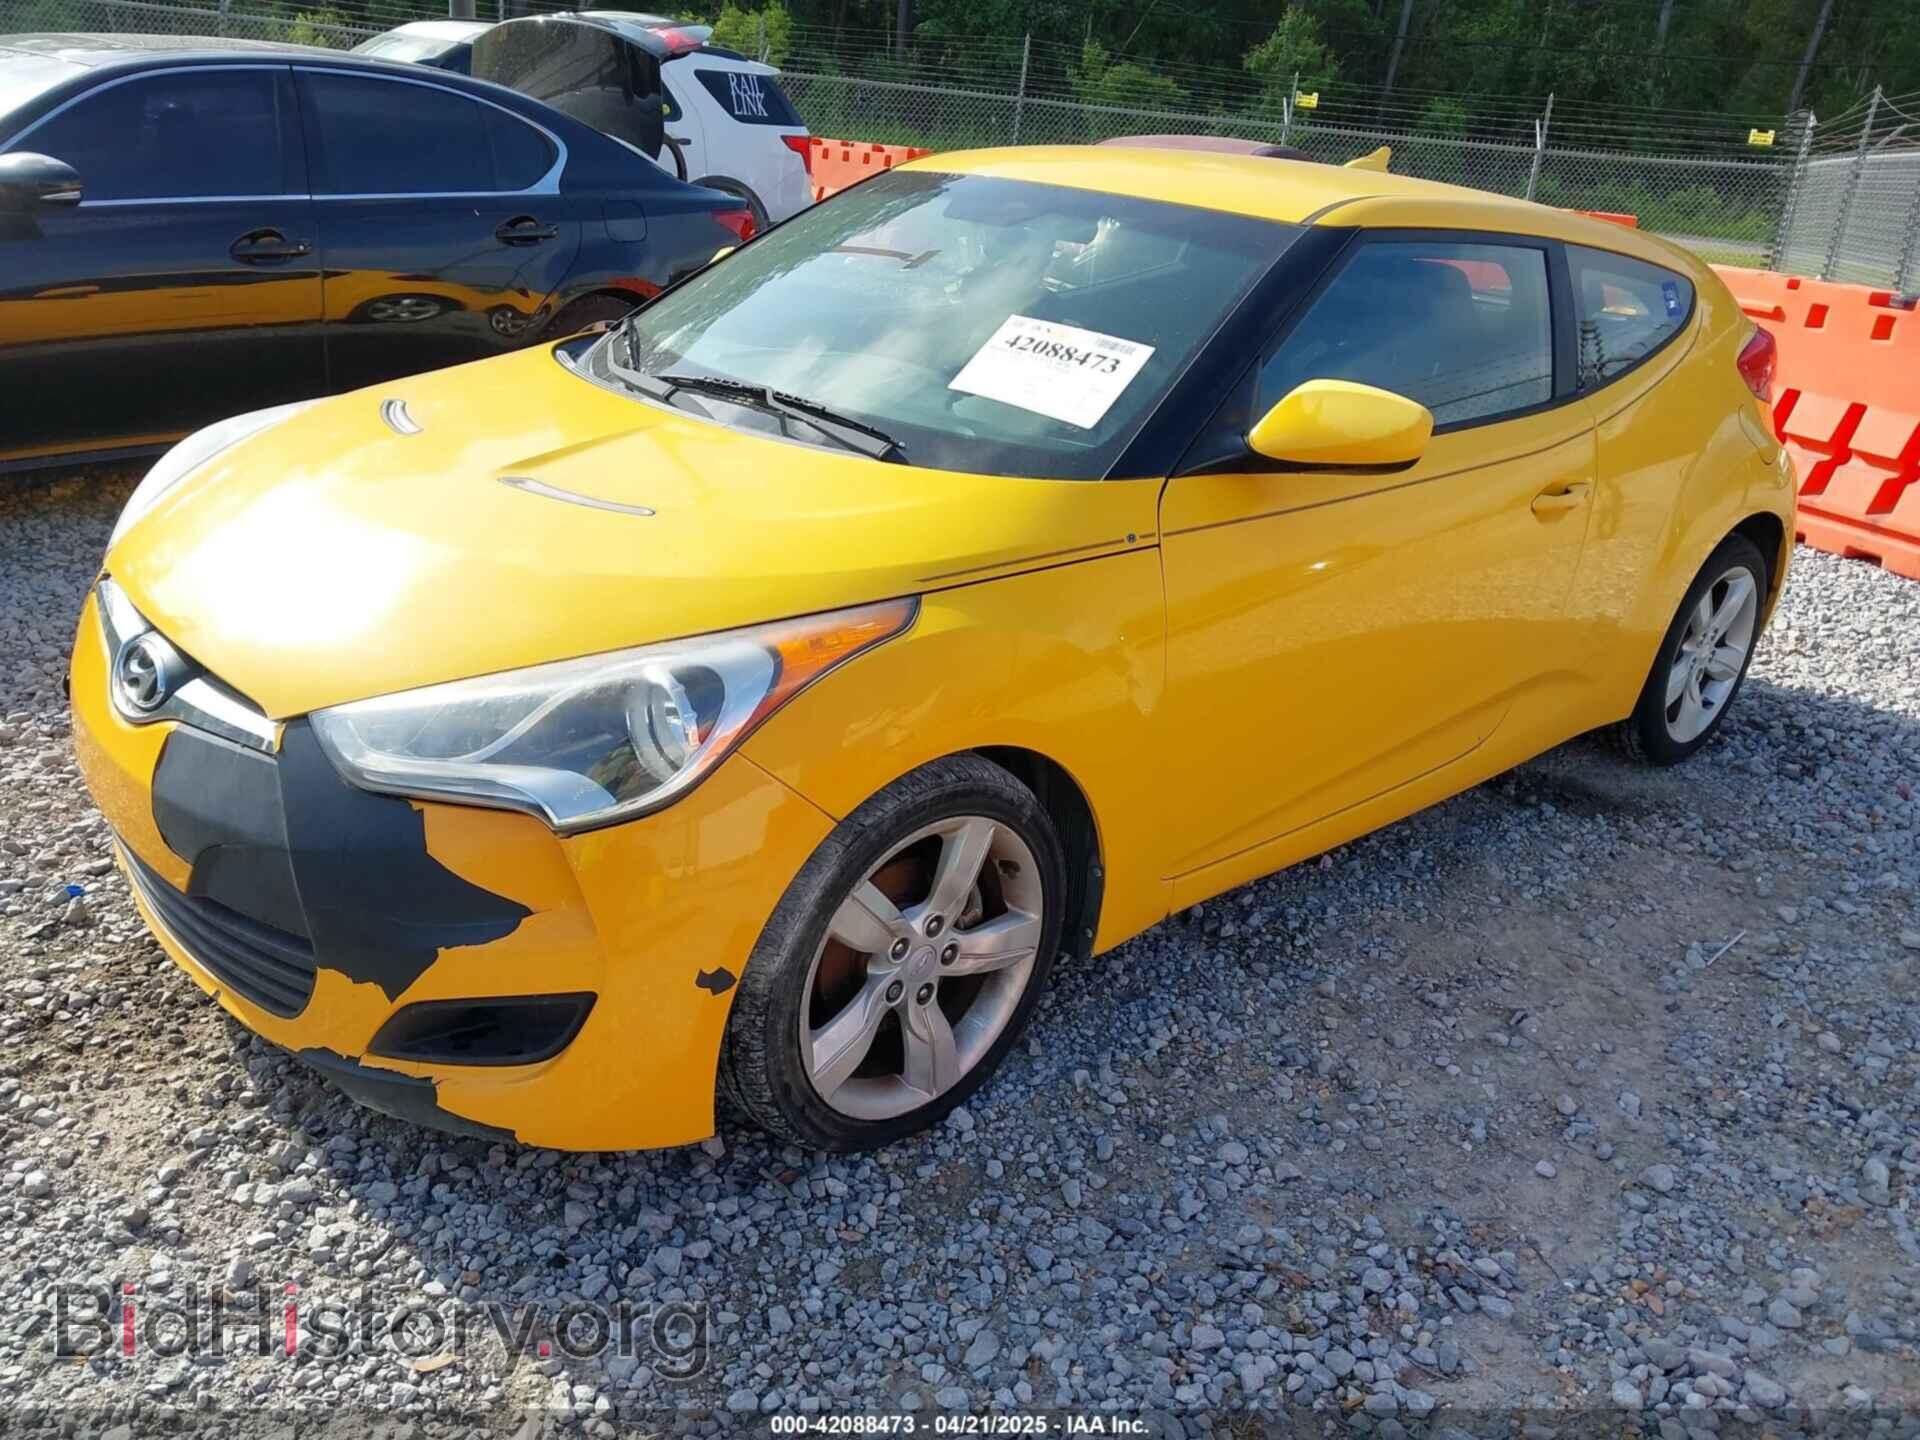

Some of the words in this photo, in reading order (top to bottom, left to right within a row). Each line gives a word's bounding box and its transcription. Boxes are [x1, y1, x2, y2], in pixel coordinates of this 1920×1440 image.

[728, 73, 764, 96] RAIL
[732, 93, 768, 116] LINK
[1004, 334, 1121, 373] 42088473
